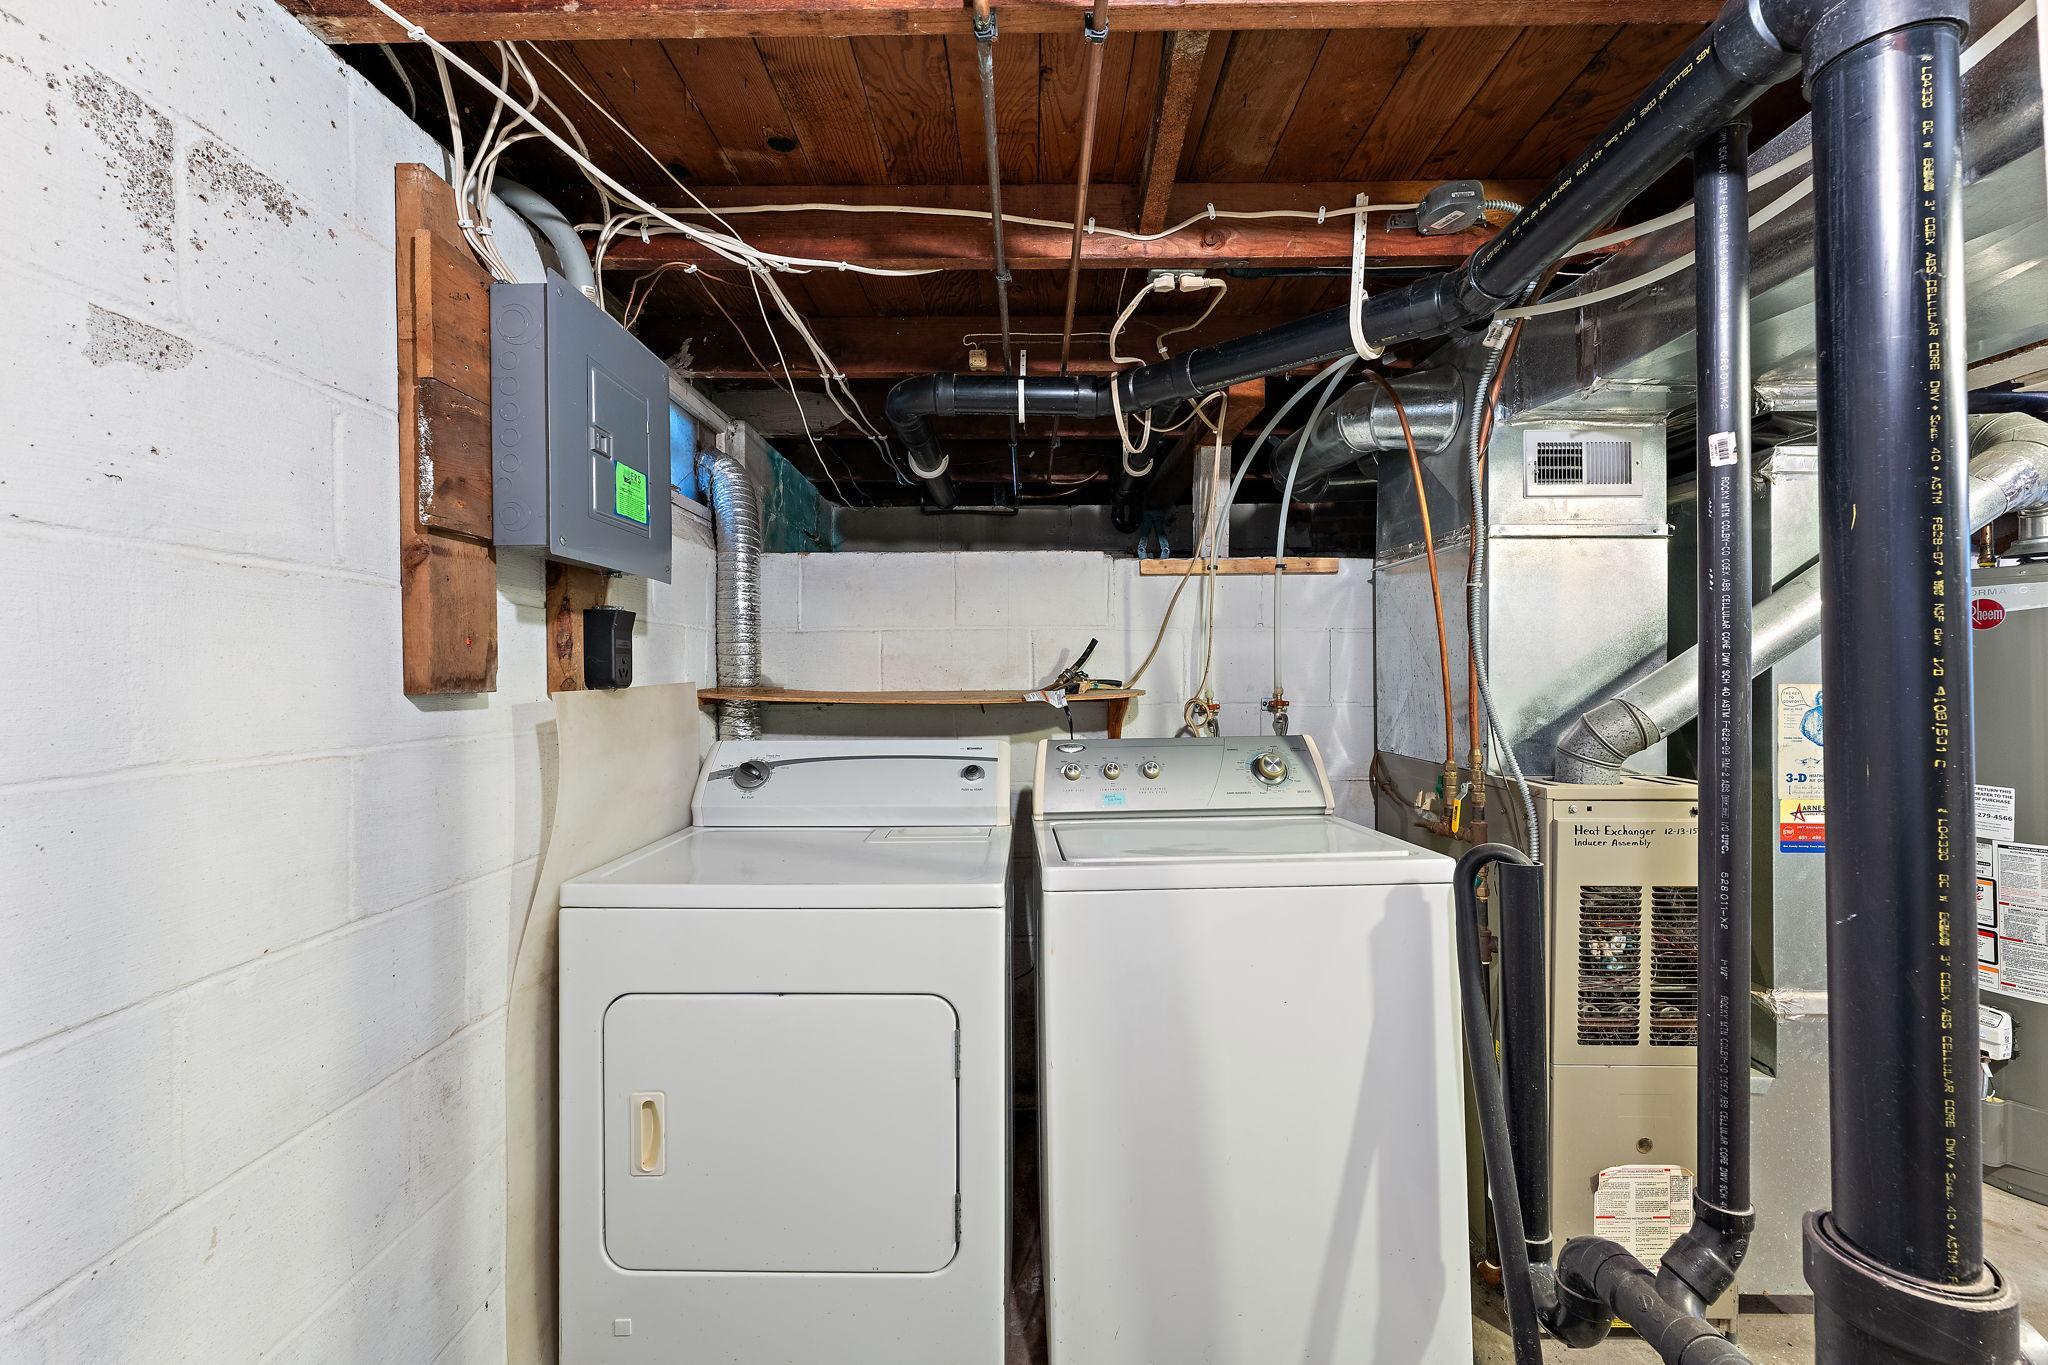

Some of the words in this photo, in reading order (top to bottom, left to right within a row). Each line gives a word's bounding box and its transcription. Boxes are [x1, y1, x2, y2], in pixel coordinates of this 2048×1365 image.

[1696, 45, 1710, 64] ABS
[1659, 62, 1693, 100] CELLULAR
[1925, 252, 1936, 273] ABS
[1925, 280, 1939, 336] CELLULAR
[1929, 342, 1940, 370] CORE
[1929, 381, 1941, 401] DWV
[1931, 448, 1941, 461] 40
[1721, 477, 1730, 499] ROCKY
[1931, 476, 1942, 504] ASTM
[1721, 578, 1730, 591] ABS
[1721, 594, 1730, 629] CELLULAR
[1934, 604, 1945, 622] NSF
[1972, 600, 2003, 624] Rheem
[1721, 632, 1730, 649] CORE
[1721, 652, 1730, 667] DWV
[1721, 687, 1730, 697] 40
[1721, 699, 1730, 718] ASTM
[1721, 720, 1730, 755] F-628-99
[1721, 779, 1730, 792] ABS
[1786, 773, 1807, 783] 3-D
[1574, 825, 1600, 836] Heat
[1604, 825, 1656, 839] Exchanger
[1574, 838, 1607, 847] Inducer
[1612, 839, 1651, 848] Assembly
[1941, 1008, 1952, 1029] ABS
[1942, 1036, 1955, 1093] CELLULAR
[1945, 1099, 1956, 1128] CORE
[1720, 1111, 1729, 1144] CELLULAR
[1720, 1147, 1729, 1164] CORE
[1945, 1138, 1956, 1160] DWV
[1720, 1167, 1729, 1182] DWV
[1946, 1205, 1957, 1220] 40
[1947, 1234, 1958, 1264] ASTM
